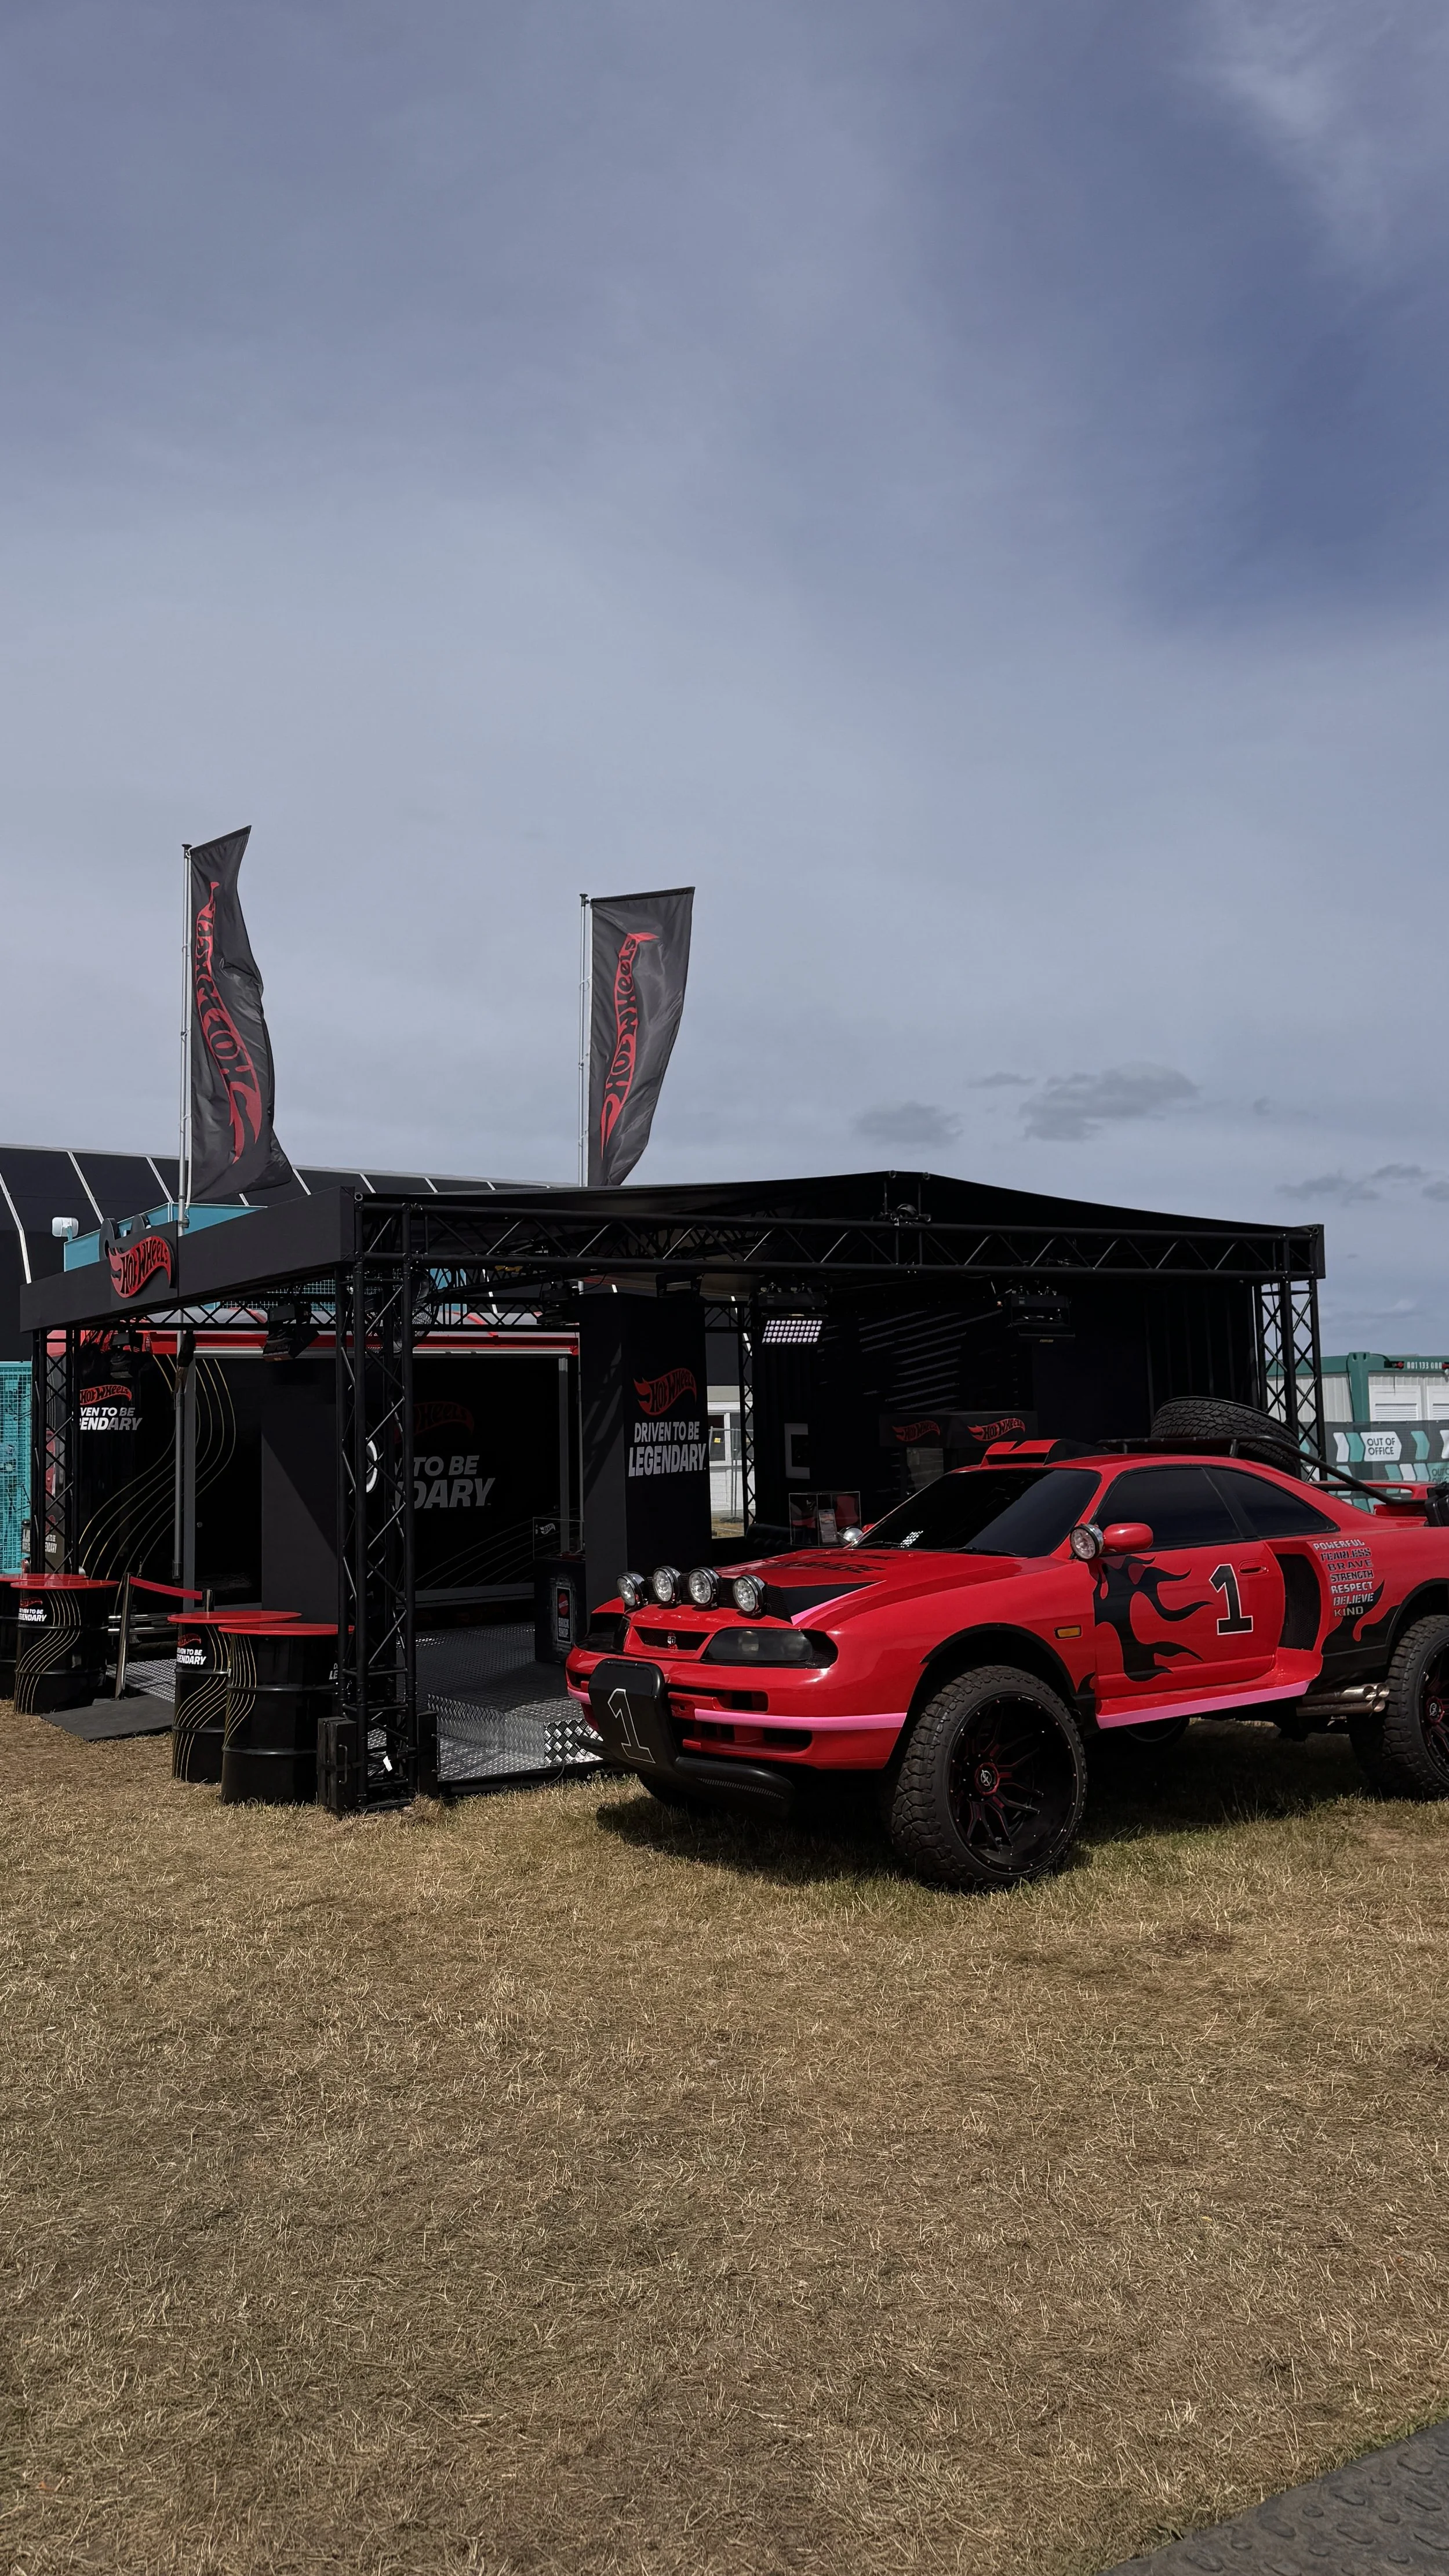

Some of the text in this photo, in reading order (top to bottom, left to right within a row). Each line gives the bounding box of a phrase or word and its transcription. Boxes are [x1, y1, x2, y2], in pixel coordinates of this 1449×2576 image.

[101, 1407, 118, 1416] TO
[119, 1407, 136, 1416] BE
[634, 1421, 700, 1443] DRIVEN TO BE
[1367, 1438, 1396, 1446] OUT OF
[1368, 1447, 1395, 1456] OFFICE
[413, 1456, 445, 1477] TO
[448, 1455, 480, 1476] BE
[1313, 1539, 1365, 1551] POWERFUL
[1320, 1548, 1372, 1562] FEARLESS
[1327, 1559, 1373, 1572] BRAVE
[1330, 1569, 1374, 1582] STRENGTH
[1331, 1581, 1373, 1594] RESPECT
[1209, 1563, 1254, 1635] 1
[1333, 1593, 1374, 1606] BELIEVE
[1334, 1606, 1364, 1617] KIND
[607, 1688, 656, 1764] 1
